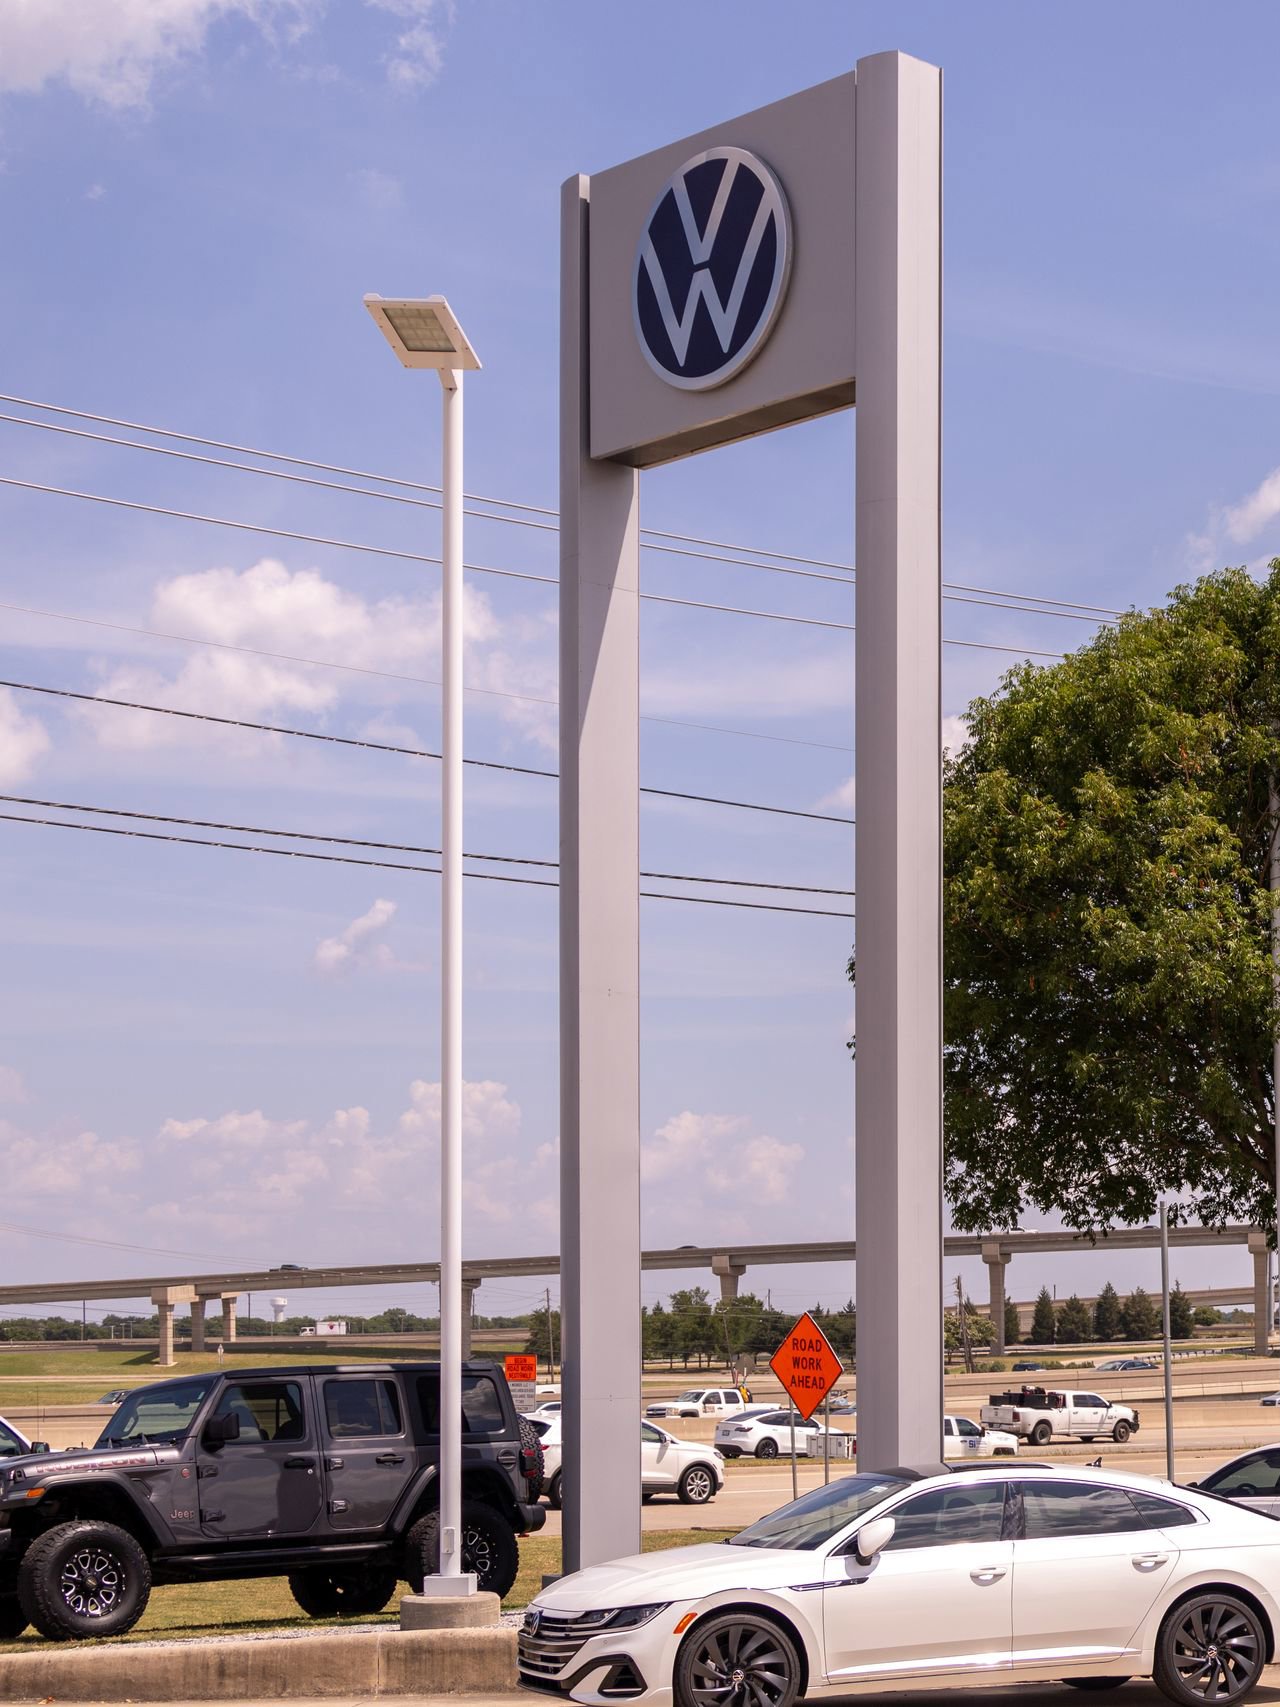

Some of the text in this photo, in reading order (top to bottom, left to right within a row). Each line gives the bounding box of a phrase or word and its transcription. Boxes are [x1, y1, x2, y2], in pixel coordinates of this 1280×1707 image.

[792, 1338, 822, 1352] ROAD
[792, 1356, 822, 1371] WORK
[790, 1375, 825, 1390] AHEAD
[170, 1509, 195, 1520] Jeep
